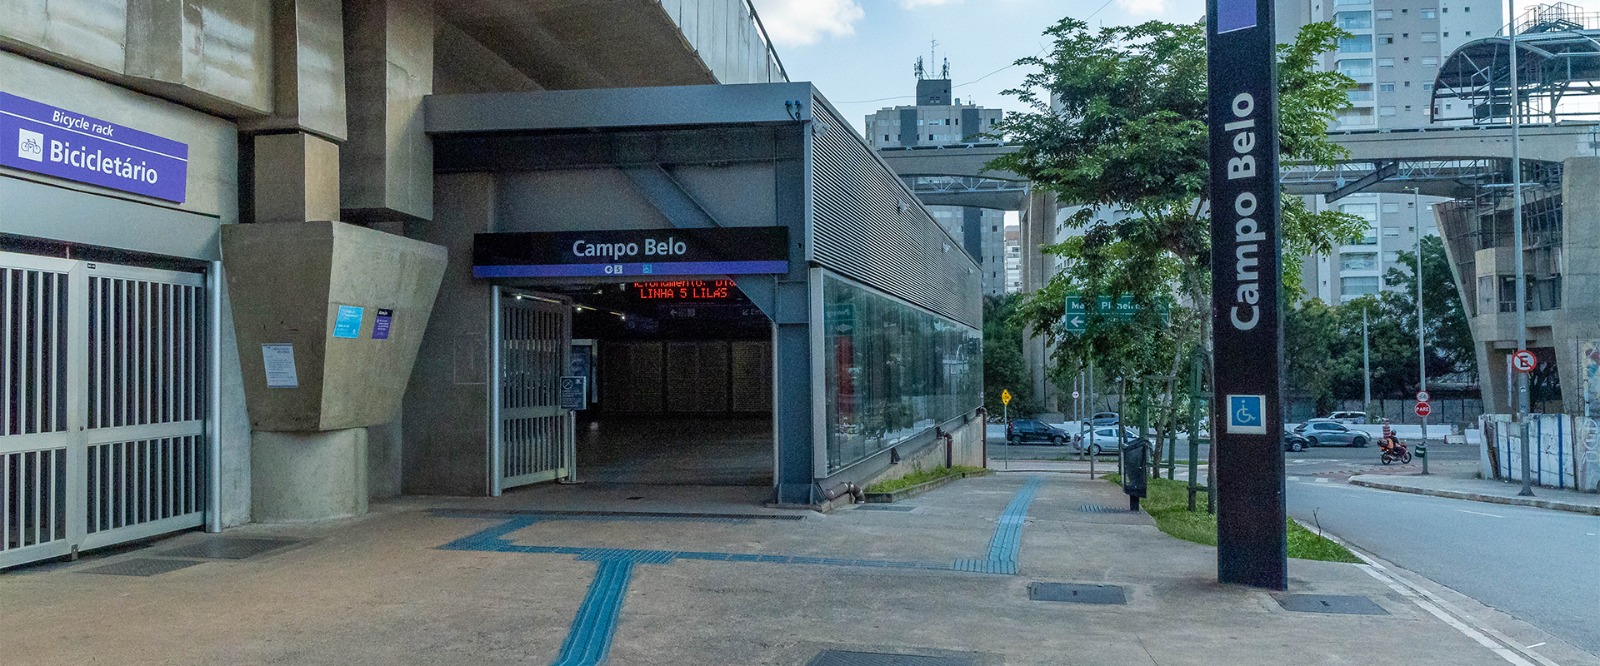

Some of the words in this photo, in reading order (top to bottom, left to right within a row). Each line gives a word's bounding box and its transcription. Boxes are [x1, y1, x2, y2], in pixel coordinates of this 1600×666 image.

[52, 110, 90, 130] Bicycle
[91, 123, 114, 137] rack
[1224, 92, 1256, 180] Belo
[50, 139, 158, 184] Bicicletário
[572, 240, 638, 260] Campo
[644, 237, 687, 255] Belo
[1230, 191, 1266, 330] Campo
[641, 288, 674, 298] LINHA
[680, 288, 687, 298] 5
[1520, 355, 1528, 368] E
